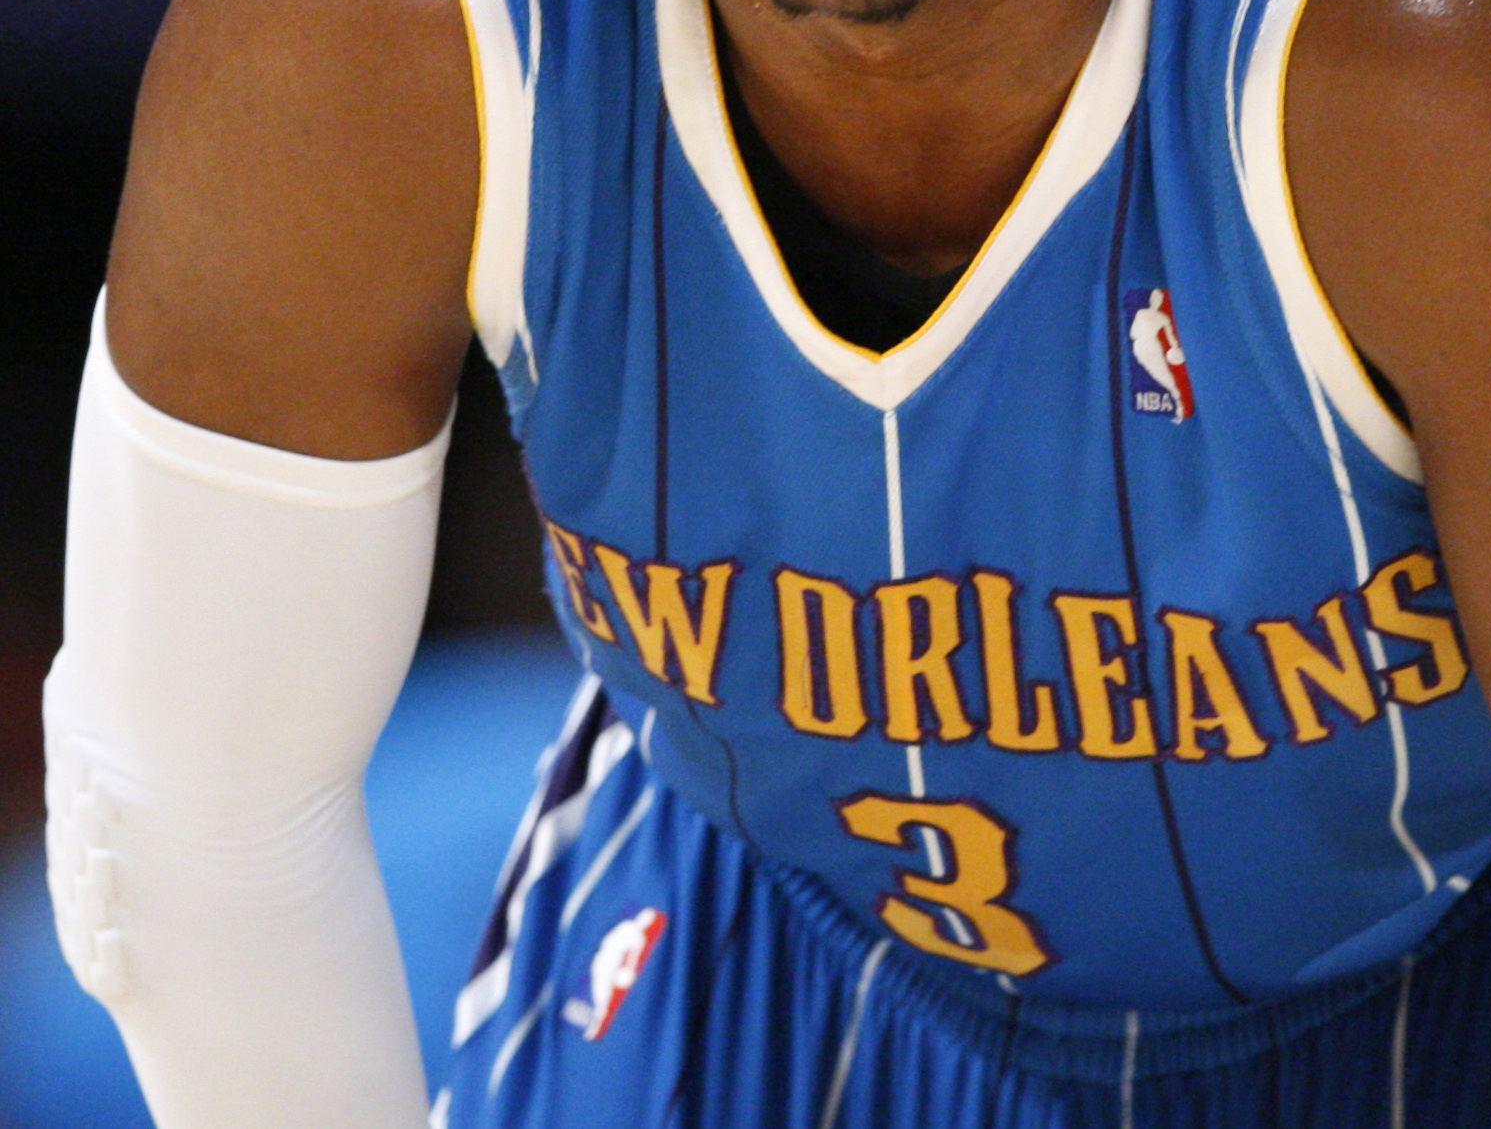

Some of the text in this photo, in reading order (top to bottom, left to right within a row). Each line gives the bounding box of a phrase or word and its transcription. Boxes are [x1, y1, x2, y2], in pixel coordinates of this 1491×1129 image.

[1135, 391, 1173, 412] NBA
[544, 520, 1472, 763] EW ORLEANS
[833, 789, 1062, 977] 3
